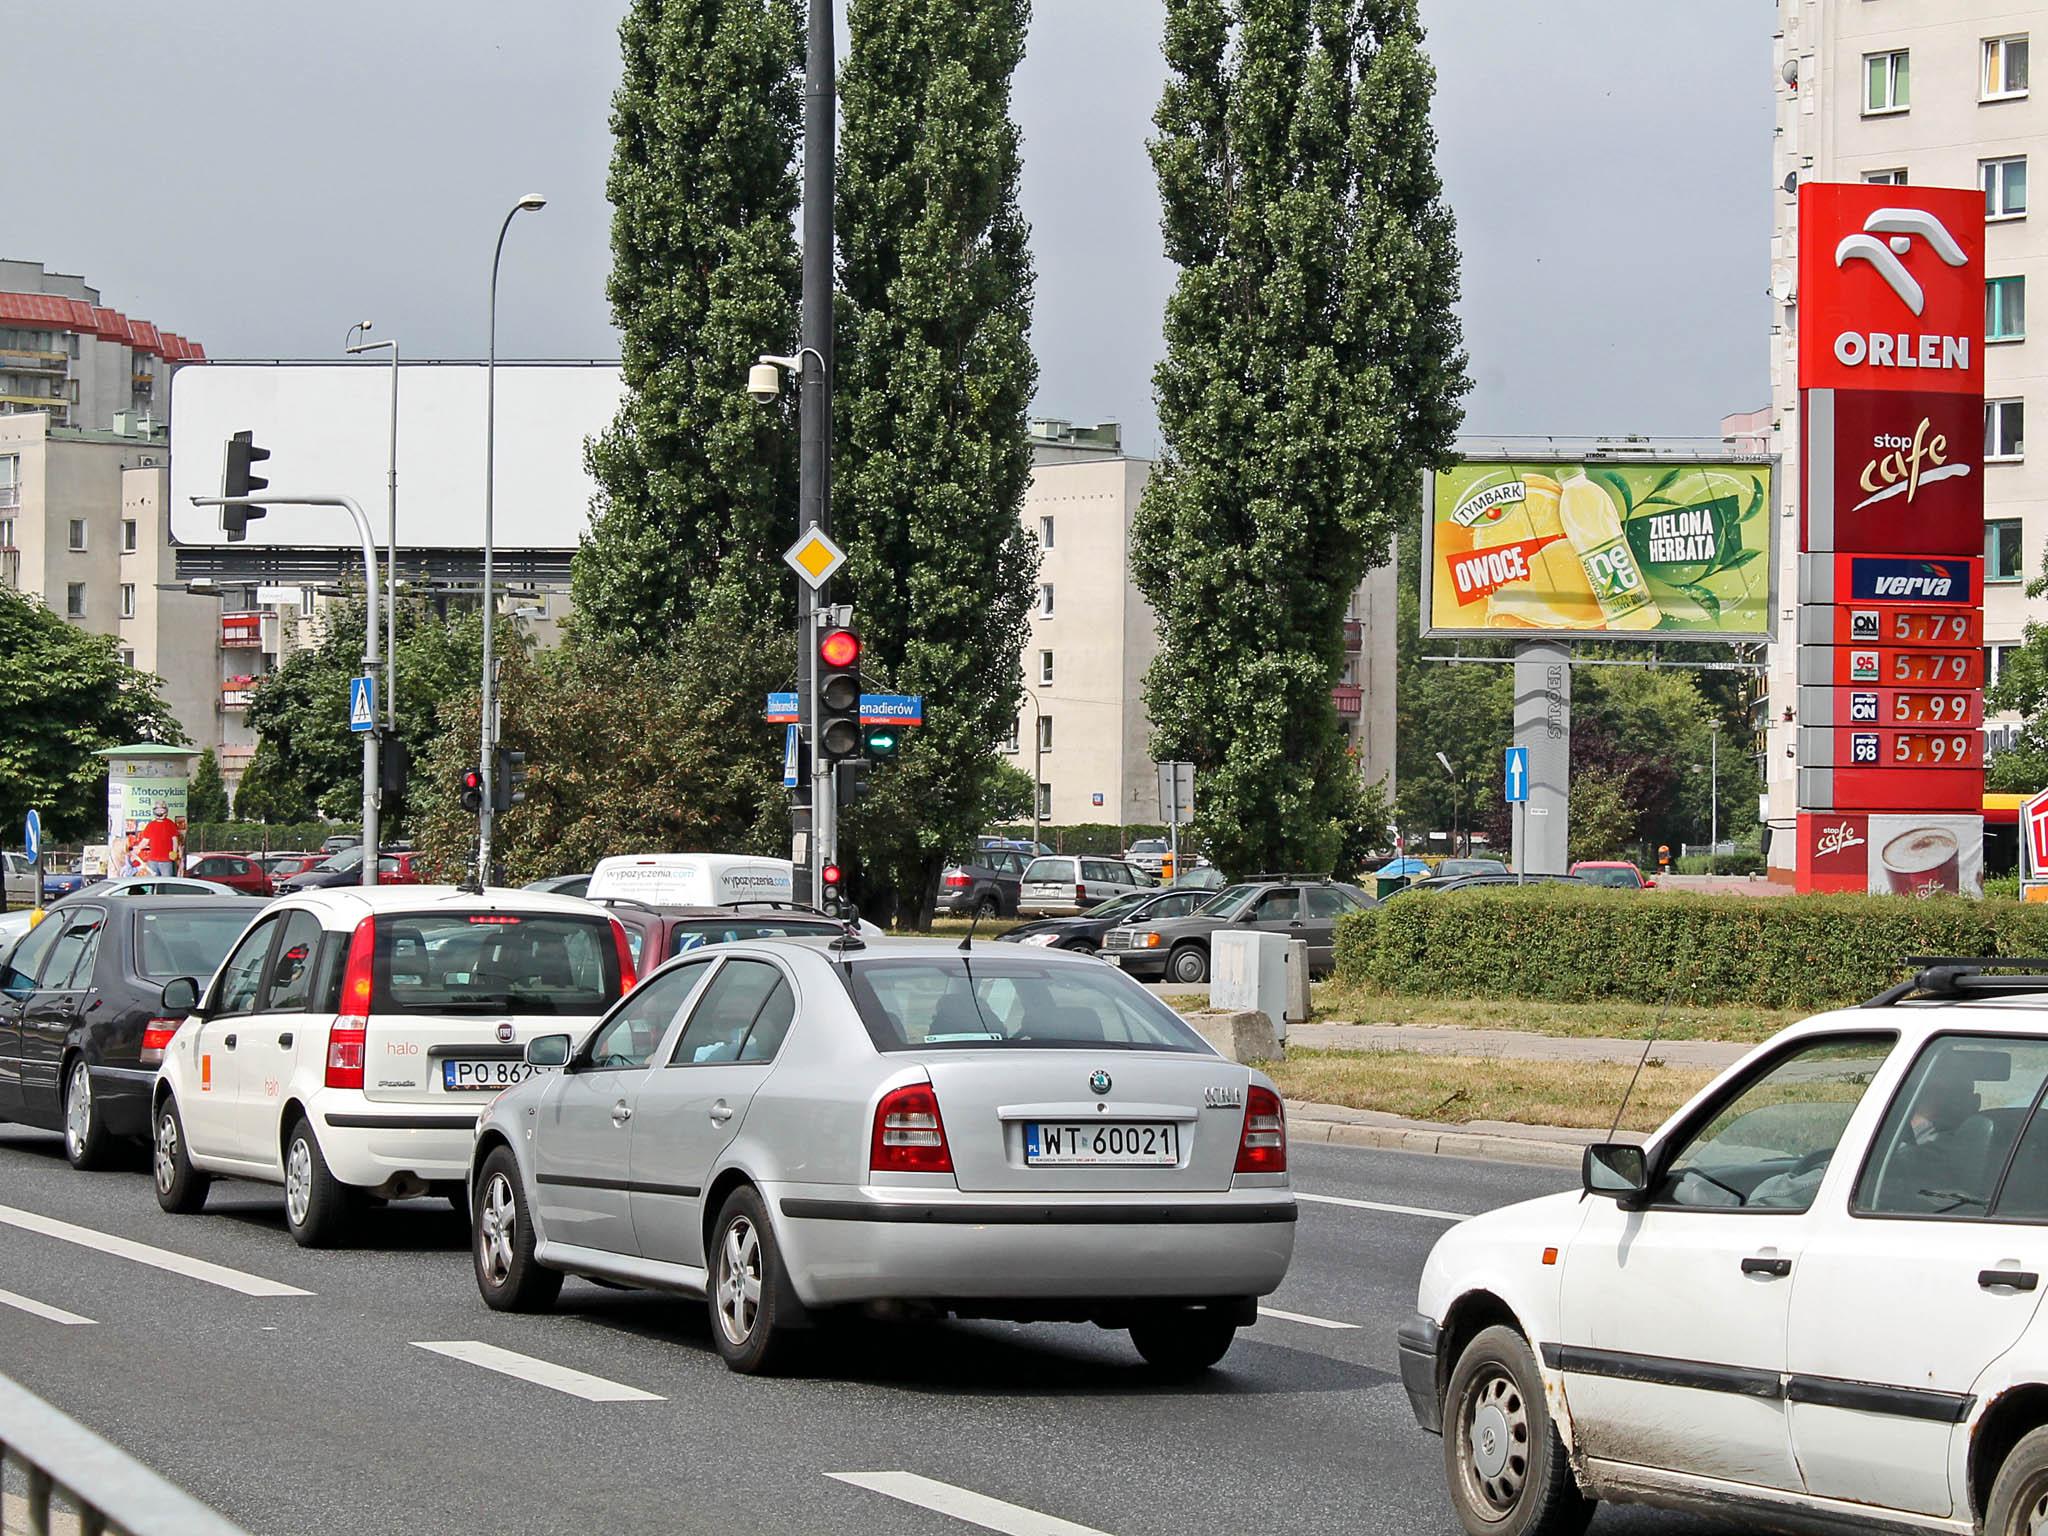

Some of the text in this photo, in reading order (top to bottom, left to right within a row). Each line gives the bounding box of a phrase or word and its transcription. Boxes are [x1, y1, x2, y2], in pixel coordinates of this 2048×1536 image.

[1834, 331, 1969, 370] ORLEN
[1873, 433, 1912, 451] stop
[1860, 417, 1947, 503] cafe
[1458, 484, 1521, 521] TYMBARK
[1649, 509, 1714, 539] ZIELONA
[1649, 534, 1715, 562] HERBATA
[1455, 546, 1528, 593] OWOCE
[1874, 576, 1952, 596] verva
[1854, 616, 1877, 629] ON
[1895, 614, 1967, 641] 5,79
[1856, 656, 1875, 671] 95
[1895, 655, 1967, 681] 5,79
[859, 702, 914, 714] enadierów
[1548, 665, 1562, 740] STRÖER
[1853, 704, 1876, 719] ON
[1895, 695, 1966, 721] 5,99
[1856, 745, 1877, 761] 98
[1895, 736, 1967, 762] 5,99
[131, 808, 152, 817] nas
[387, 1042, 419, 1056] halo
[458, 1063, 552, 1084] PO 862
[265, 1076, 280, 1097] halo
[1028, 1144, 1038, 1153] PL
[1043, 1127, 1170, 1155] WT 60021
